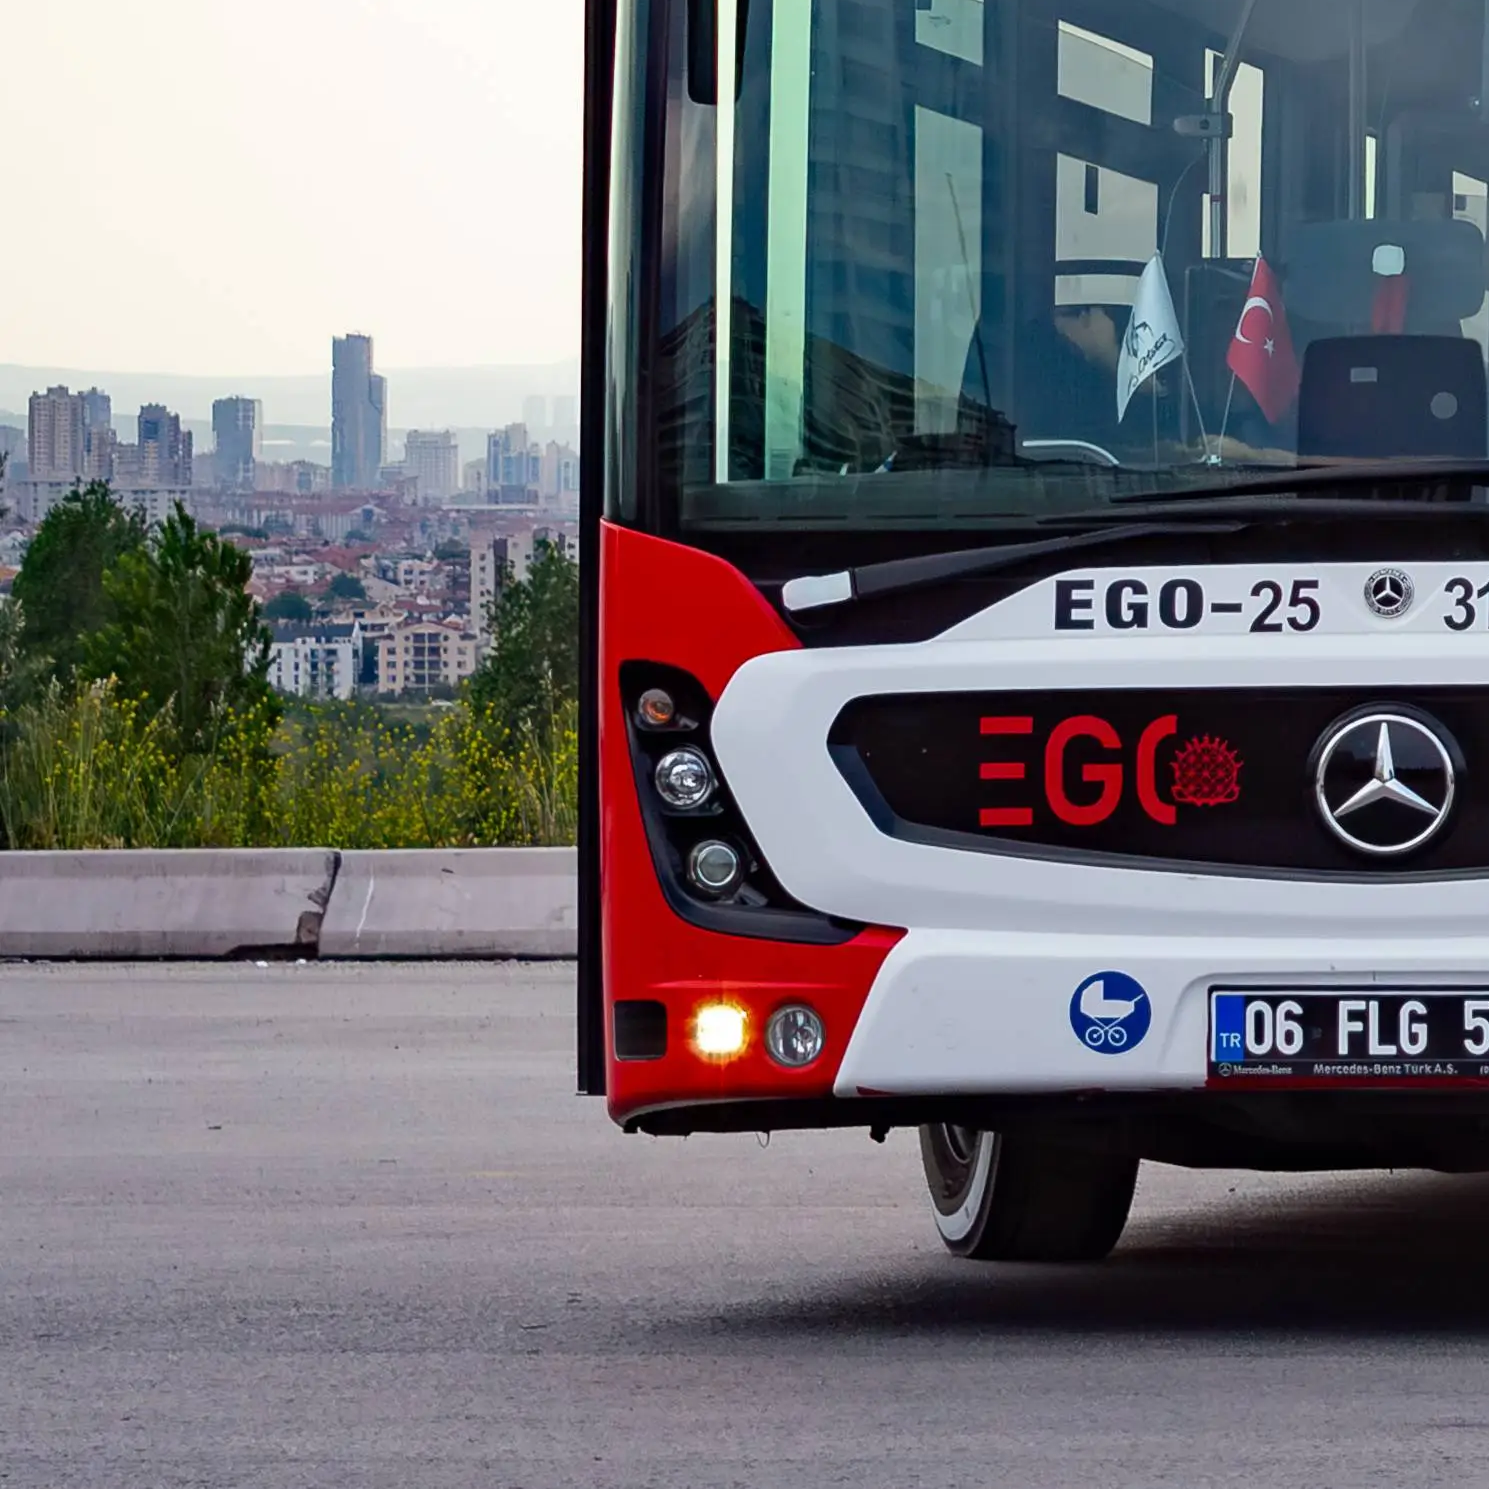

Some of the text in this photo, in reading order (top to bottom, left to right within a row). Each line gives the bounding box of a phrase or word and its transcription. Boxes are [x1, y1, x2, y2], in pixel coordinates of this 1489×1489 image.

[1053, 576, 1322, 633] EGO-25
[1219, 1032, 1241, 1049] TR
[1245, 1000, 1304, 1055] 06
[1337, 1000, 1428, 1055] FLG
[1313, 1063, 1401, 1075] Mercedes-Benz
